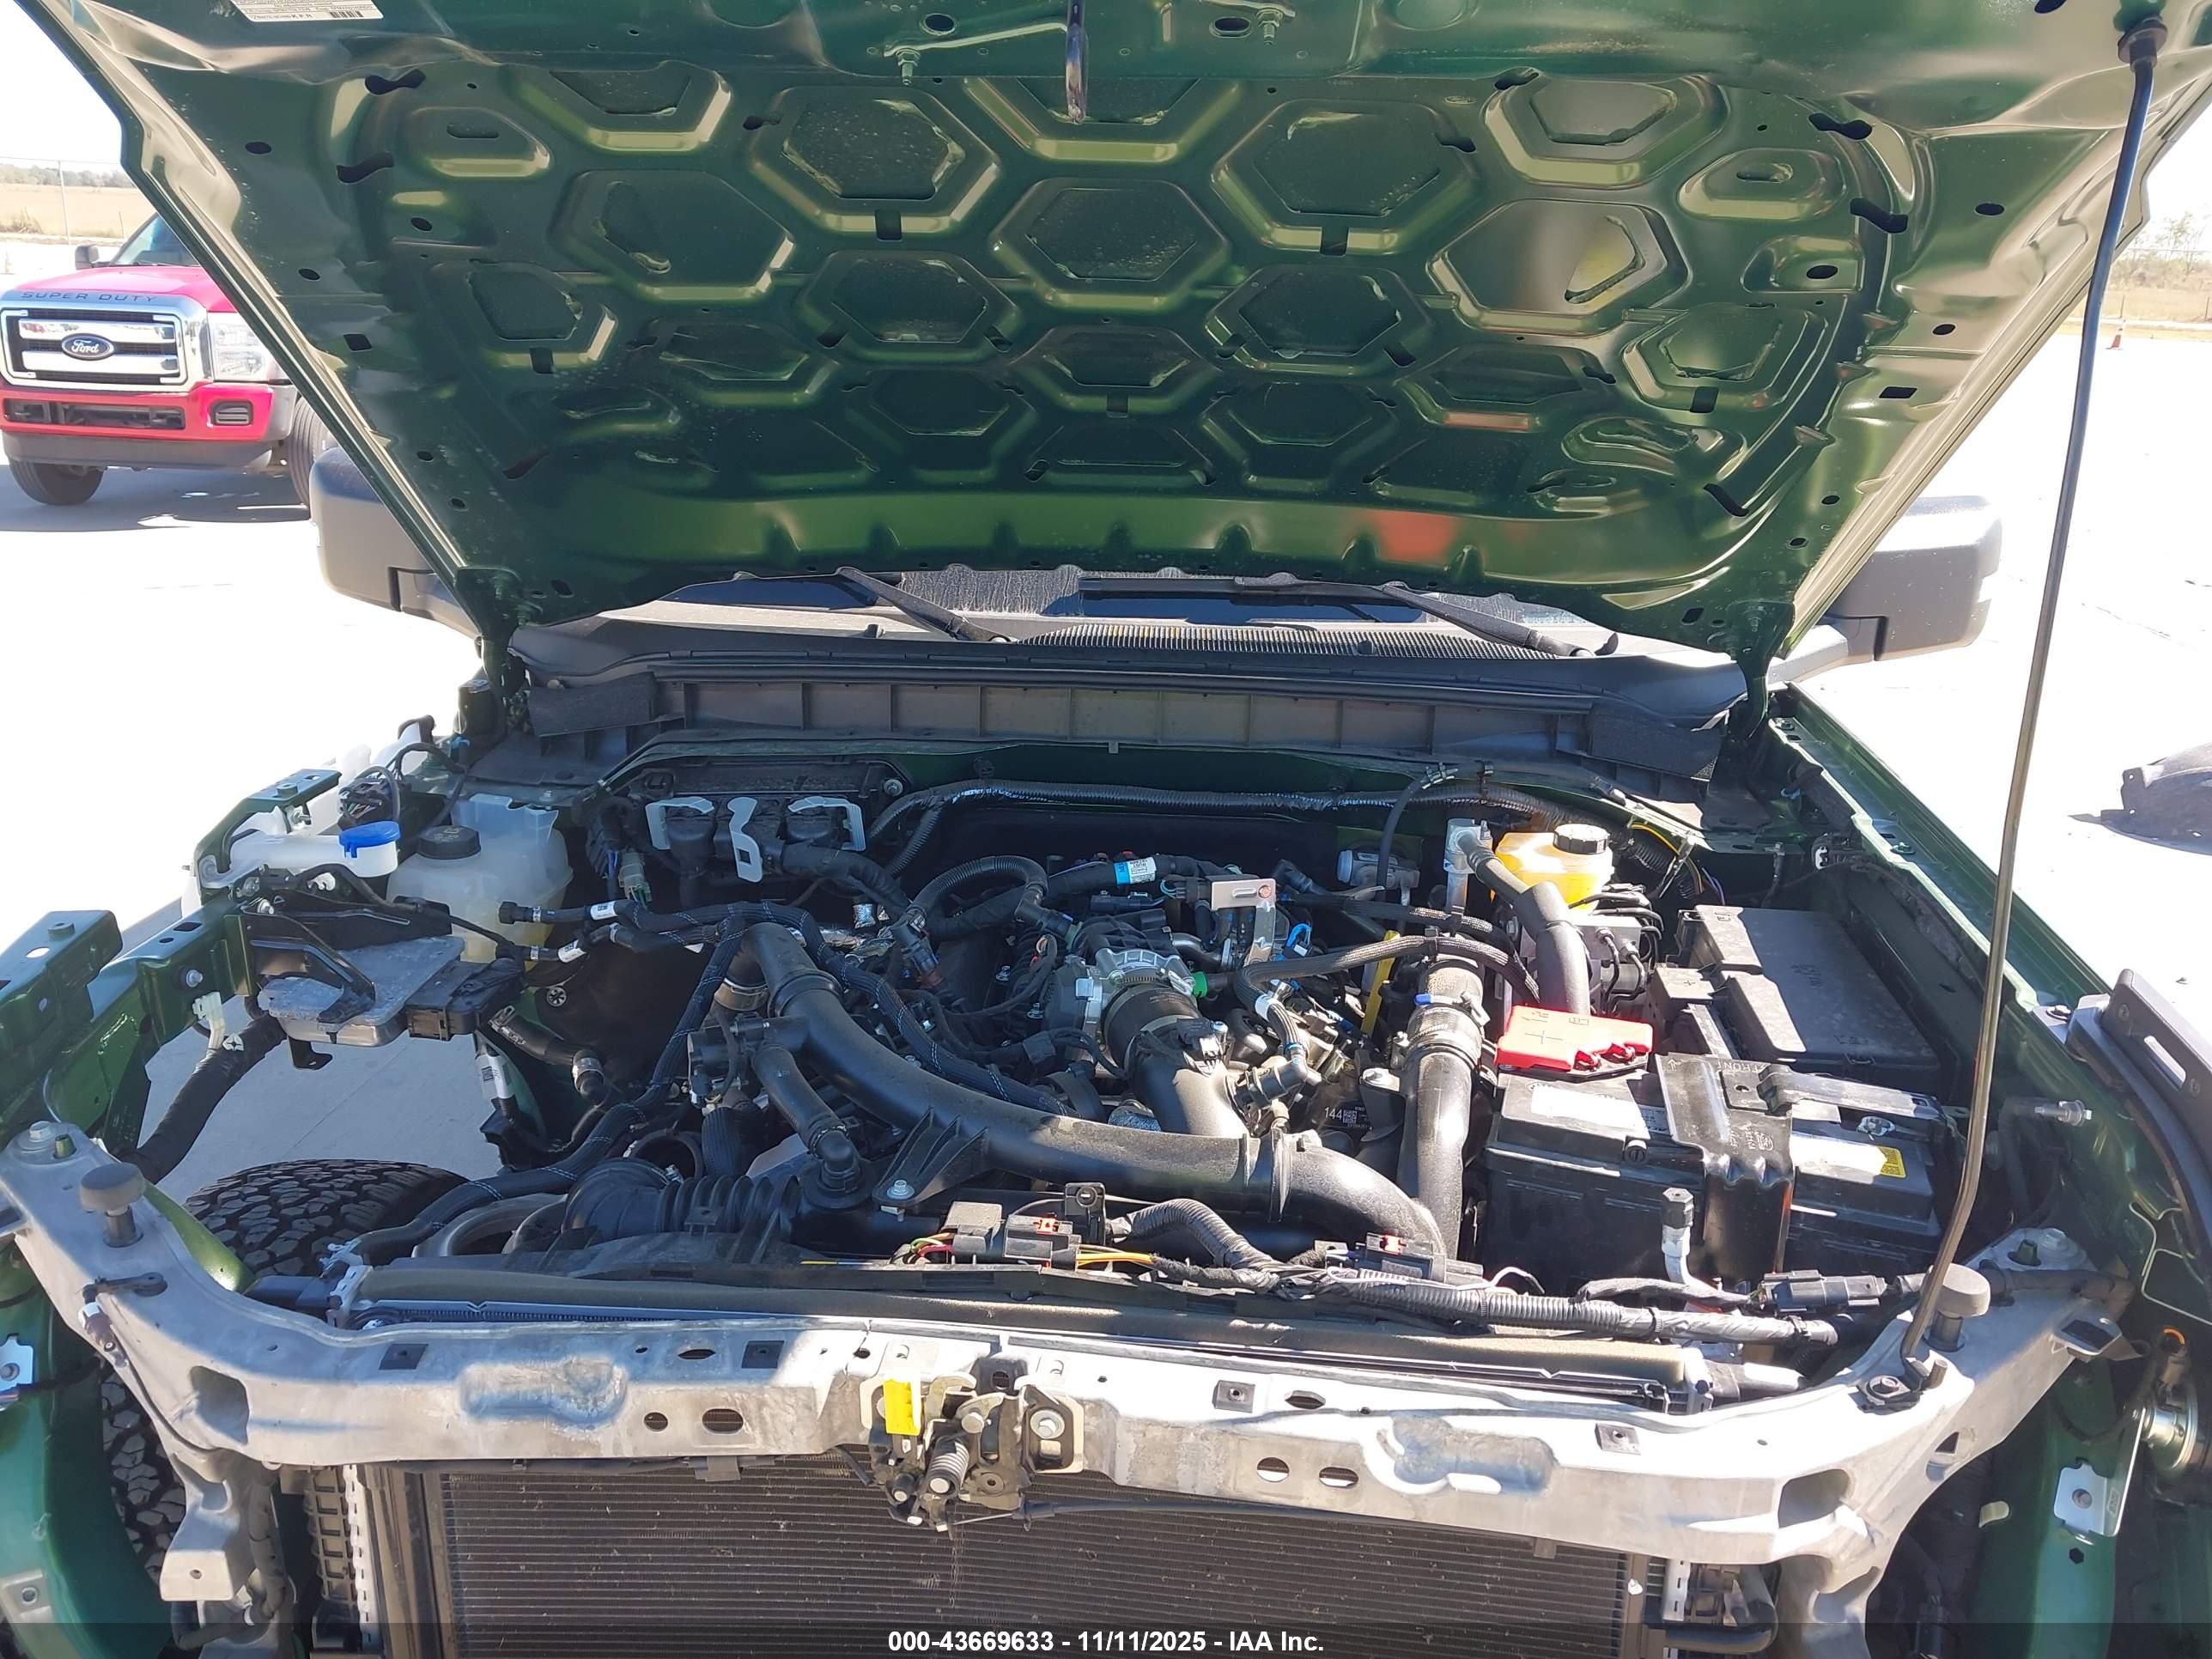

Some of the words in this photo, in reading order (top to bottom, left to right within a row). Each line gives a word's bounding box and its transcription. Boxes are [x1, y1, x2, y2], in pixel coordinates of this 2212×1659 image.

[21, 291, 88, 300] SUPER
[99, 294, 156, 302] DUTY
[71, 339, 100, 354] Ford
[1325, 1106, 1342, 1120] 144
